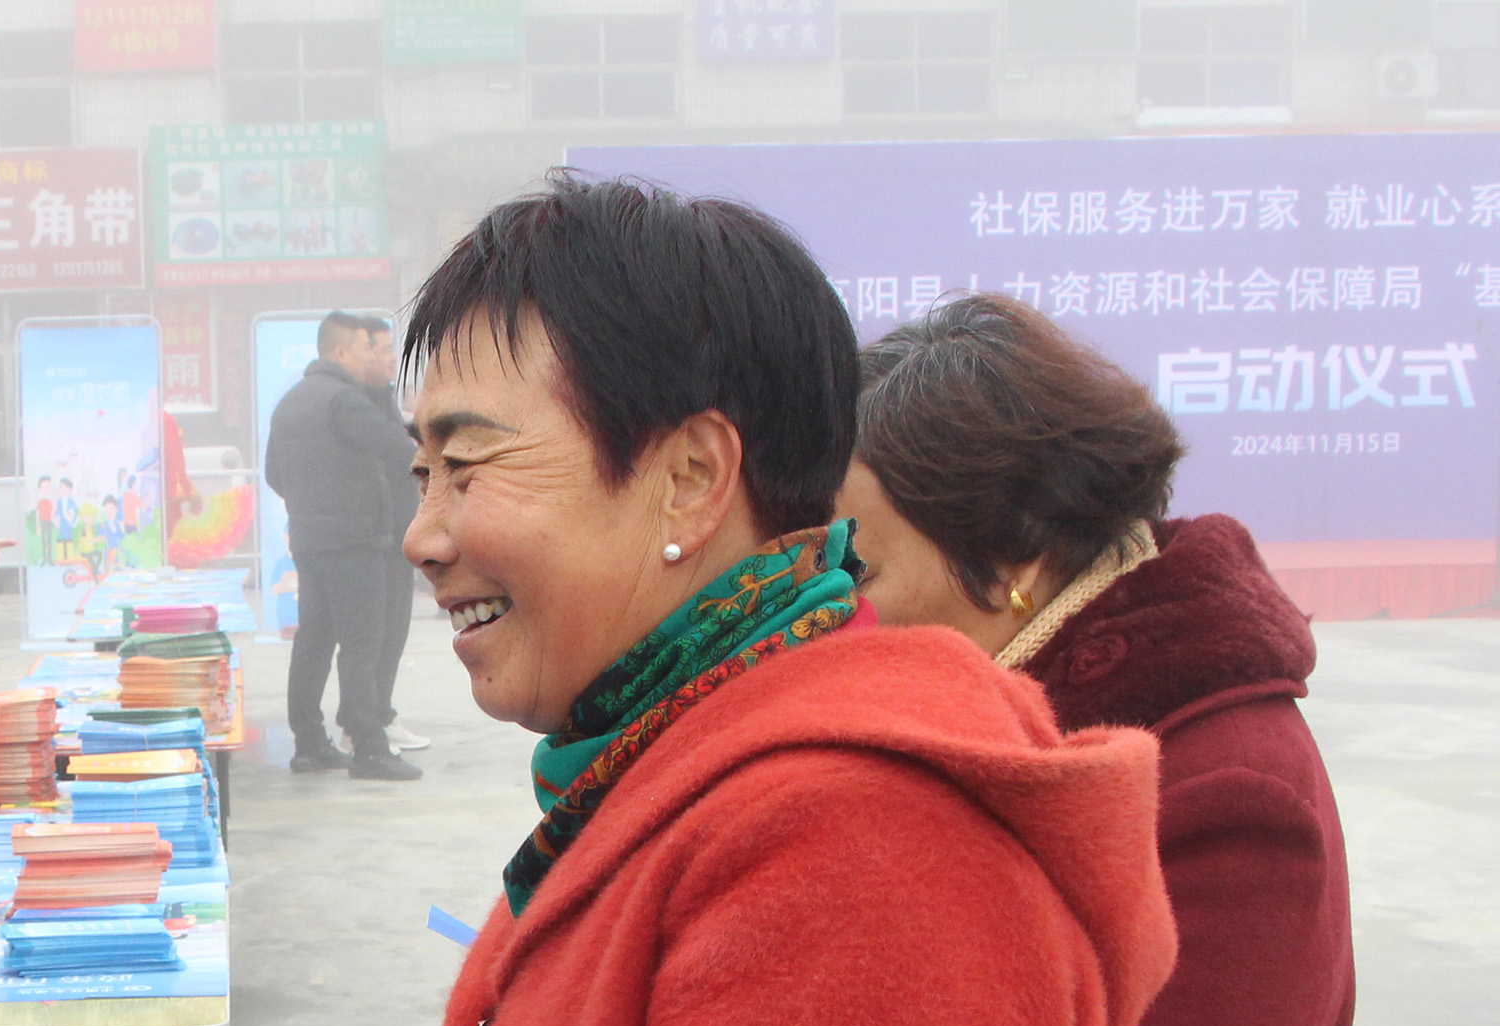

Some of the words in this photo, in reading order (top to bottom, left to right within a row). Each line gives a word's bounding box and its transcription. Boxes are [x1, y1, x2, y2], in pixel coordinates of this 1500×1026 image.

[968, 186, 1301, 237] 社保服务进万家
[833, 263, 1423, 322] 阳县力资源和社会保障局
[1157, 342, 1479, 414] 启动仪式
[1230, 431, 1402, 456] 2024年11月15日
